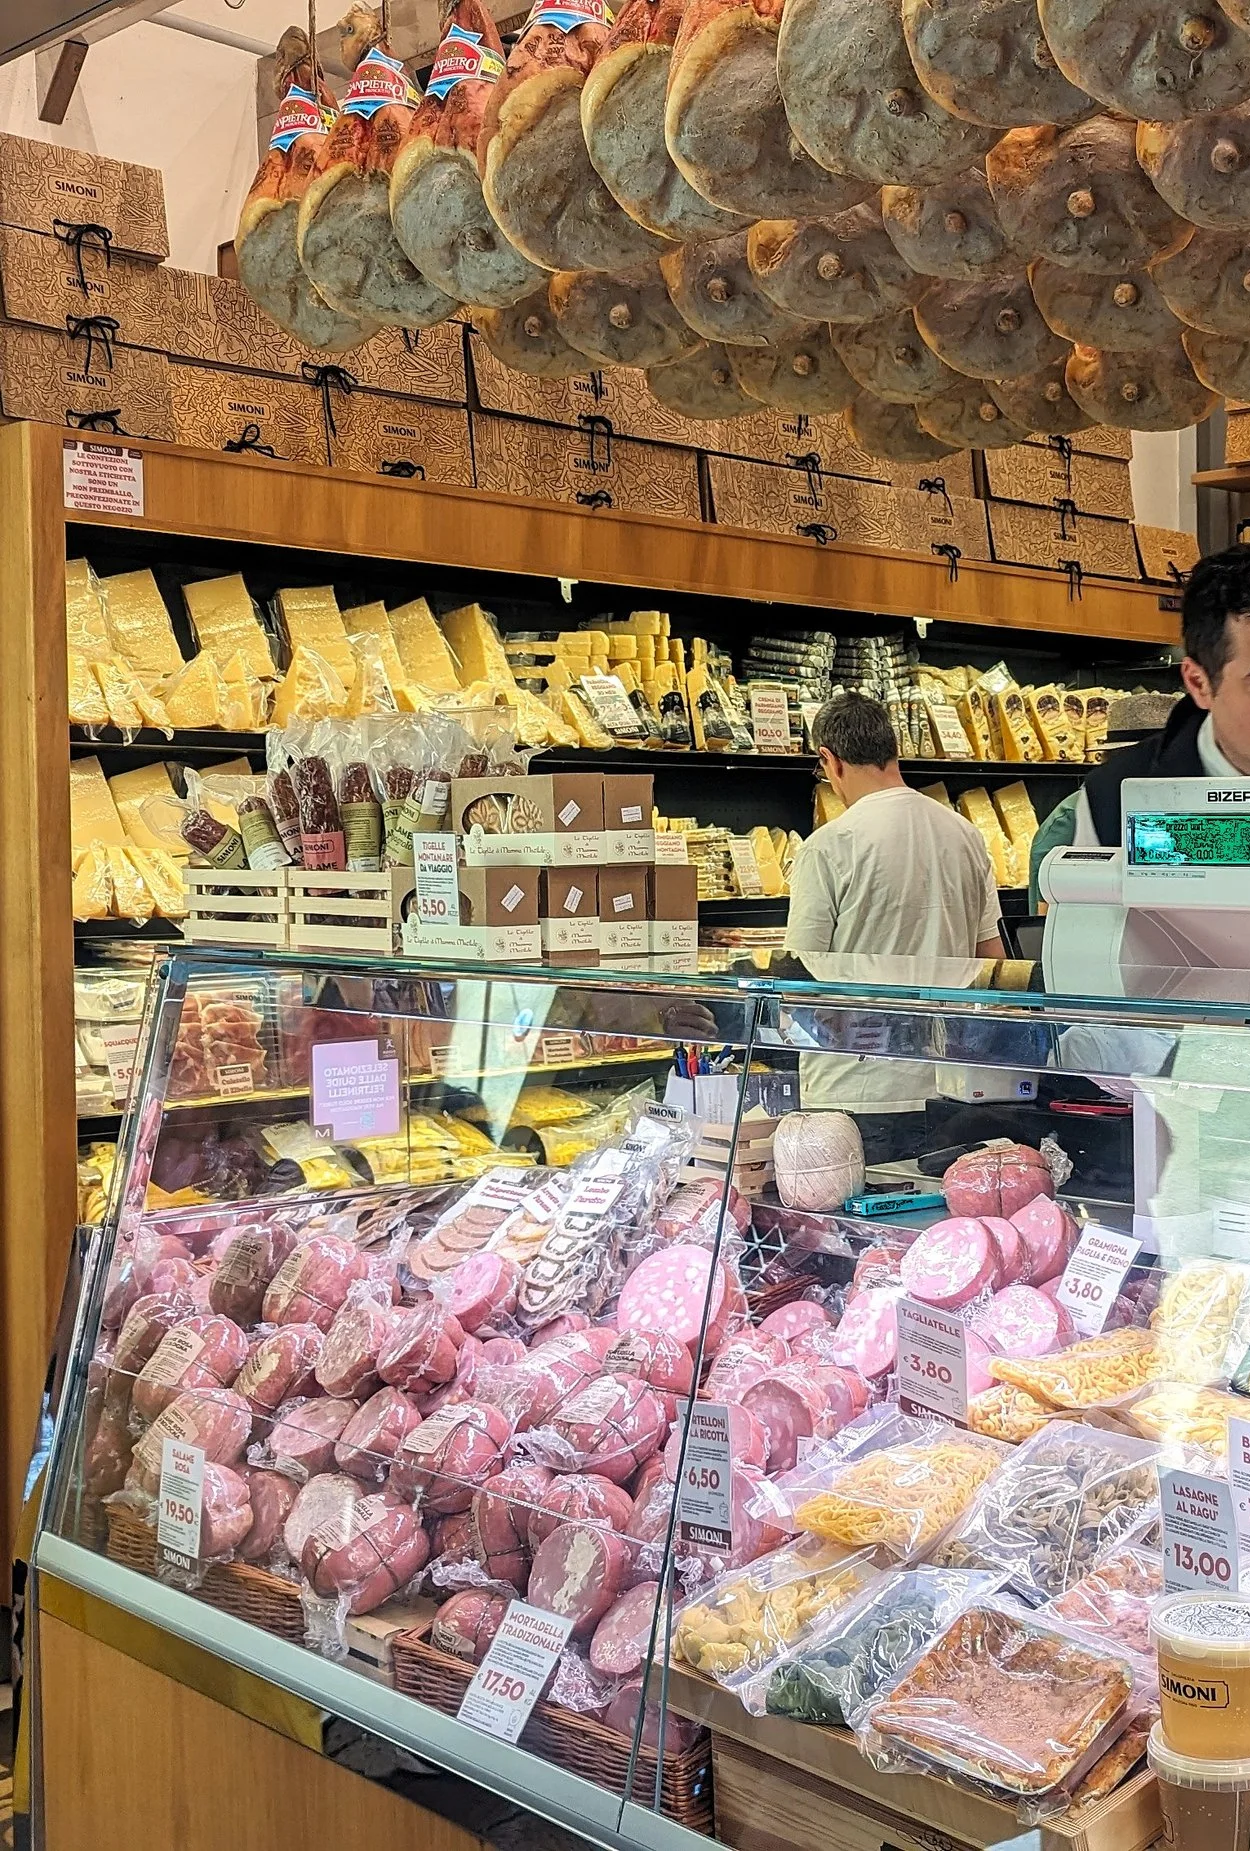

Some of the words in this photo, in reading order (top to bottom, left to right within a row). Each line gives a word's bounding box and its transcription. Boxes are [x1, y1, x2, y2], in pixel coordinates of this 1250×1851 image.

[54, 180, 98, 199] SIMONI
[66, 371, 107, 388] SIMONI
[227, 401, 265, 417] SIMONI
[382, 424, 417, 439] SIMONI
[77, 452, 86, 460] LE
[86, 453, 129, 465] CONFEZIONI
[89, 444, 117, 455] SIMONI
[69, 467, 98, 477] NOSTRA
[98, 471, 137, 483] ETICHETTA
[71, 459, 118, 471] SOTTOVUOTO
[118, 465, 134, 474] CON
[72, 484, 88, 492] NON
[87, 478, 107, 486] SONO
[108, 480, 119, 488] UN
[65, 491, 132, 506] PRECONFEZIONATE
[73, 501, 102, 510] QUESTO
[102, 504, 133, 514] NEGOZIO
[613, 726, 640, 735] SIMONI
[217, 837, 240, 864] SIMONI
[422, 841, 446, 851] TIGELLE
[420, 863, 428, 873] DA
[428, 864, 453, 874] VIAGGIO
[422, 898, 446, 917] 5,50
[647, 1106, 678, 1119] SIMONI
[1088, 1237, 1128, 1257] GRAMIGNA
[1076, 1246, 1101, 1261] PAGLIA
[1101, 1253, 1108, 1262] E
[1107, 1255, 1130, 1269] FIENO
[1068, 1277, 1104, 1302] 3,80
[901, 1307, 961, 1339] TAGLIATELLE
[910, 1352, 953, 1385] 3,80
[700, 1430, 730, 1444] RICOTTA
[171, 1448, 195, 1465] SALAME
[174, 1460, 191, 1475] ROSA
[688, 1466, 720, 1490] 6,50
[1172, 1482, 1219, 1507] LASAGNE
[164, 1498, 195, 1525] 19,50
[1176, 1500, 1189, 1514] AL
[1189, 1503, 1220, 1521] RAGU'
[689, 1525, 724, 1545] SIMONI
[162, 1548, 191, 1571] SIMONI
[1173, 1542, 1232, 1582] 13,00
[509, 1611, 565, 1640] MORTADELLA
[501, 1622, 563, 1654] TRADIZIONALE
[481, 1668, 527, 1702] 17,50
[1160, 1673, 1217, 1703] SIMONI
